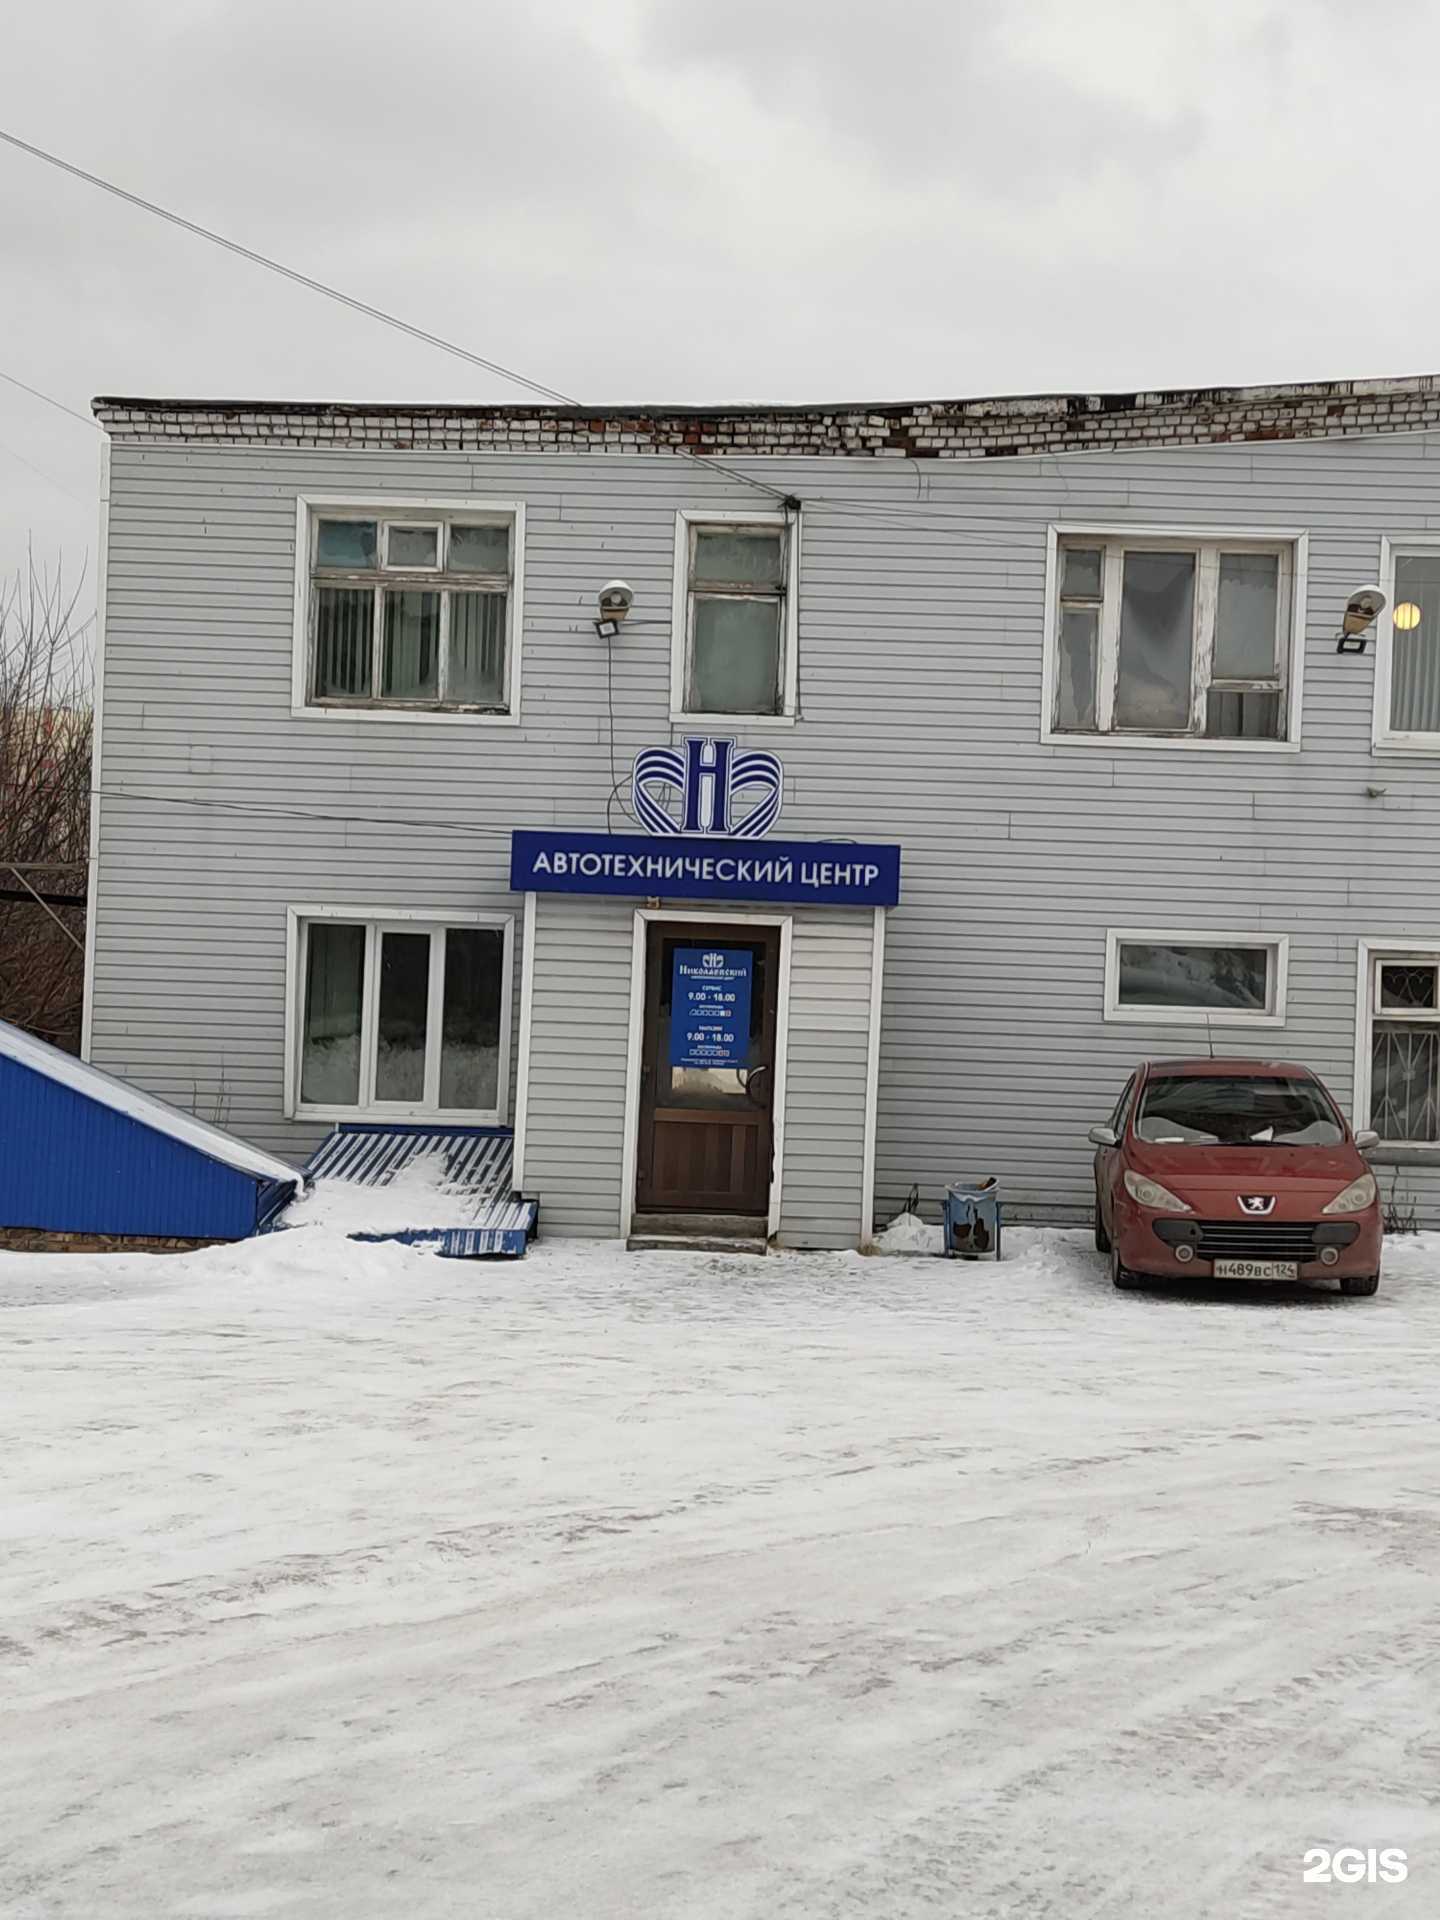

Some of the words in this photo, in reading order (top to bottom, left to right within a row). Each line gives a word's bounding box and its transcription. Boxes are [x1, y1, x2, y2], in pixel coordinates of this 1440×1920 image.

[532, 851, 793, 883] АВТОТЕХНИЧЕСКИЙ
[800, 861, 879, 888] ЦЕНТР
[688, 992, 706, 1000] 9.00
[687, 1032, 704, 1041] 9.00
